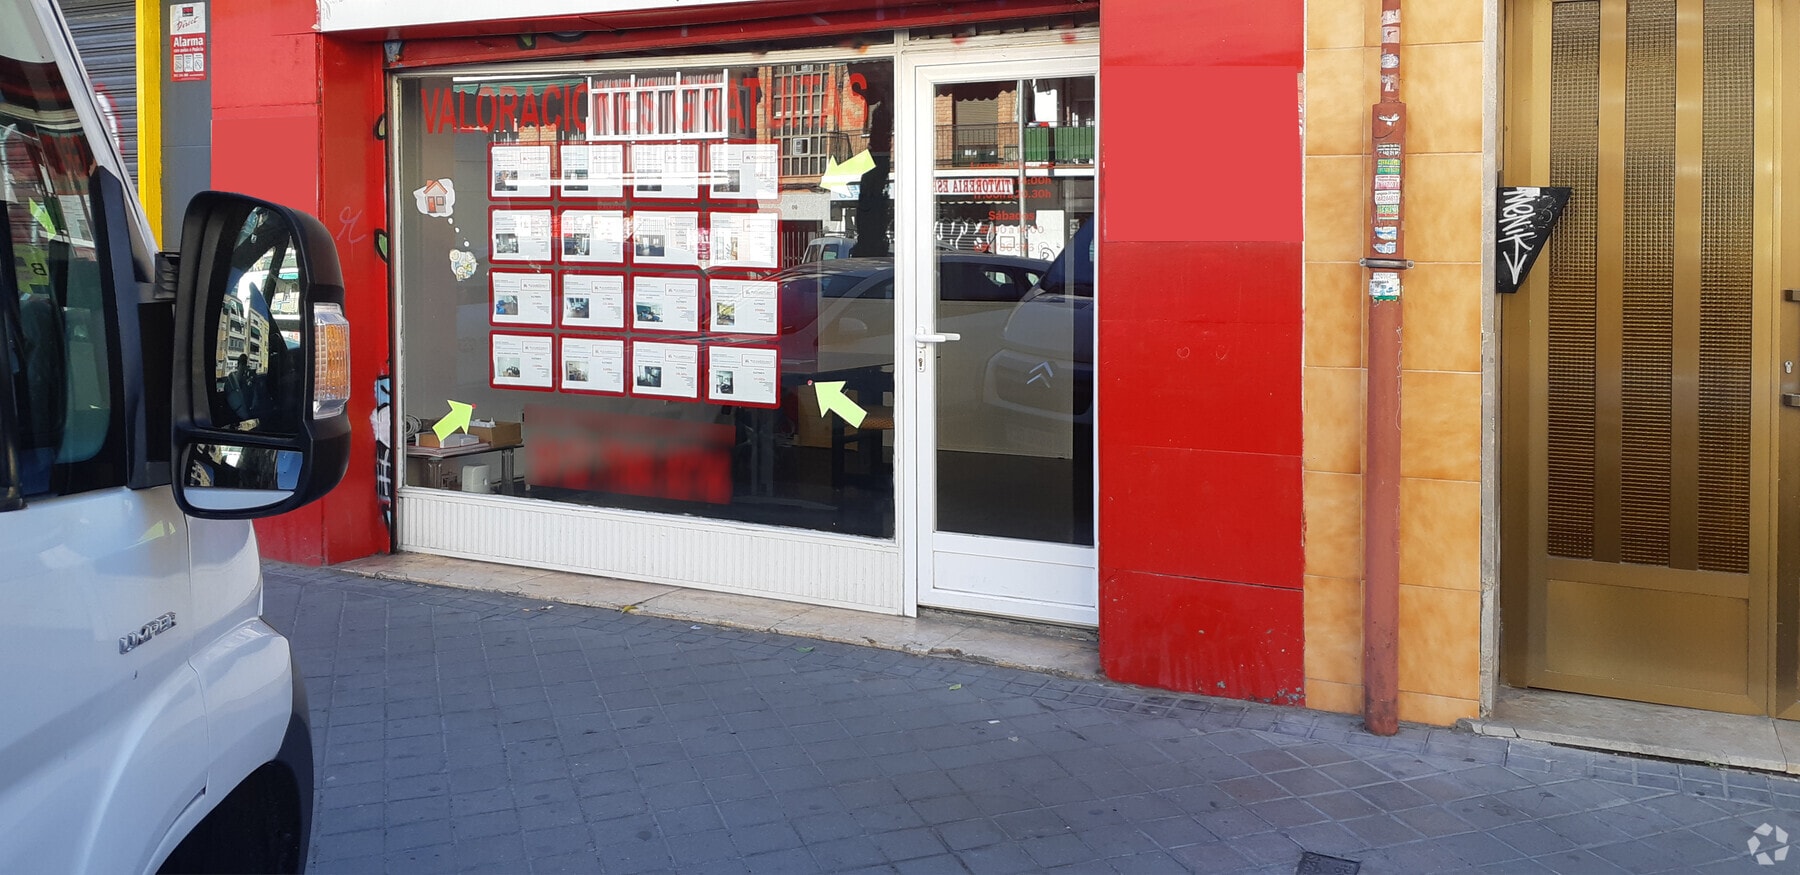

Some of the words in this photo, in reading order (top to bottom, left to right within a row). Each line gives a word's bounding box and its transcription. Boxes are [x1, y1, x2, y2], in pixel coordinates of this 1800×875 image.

[173, 36, 204, 47] Alarma
[421, 79, 658, 134] VALORACIONES
[988, 210, 1035, 221] Sábados
